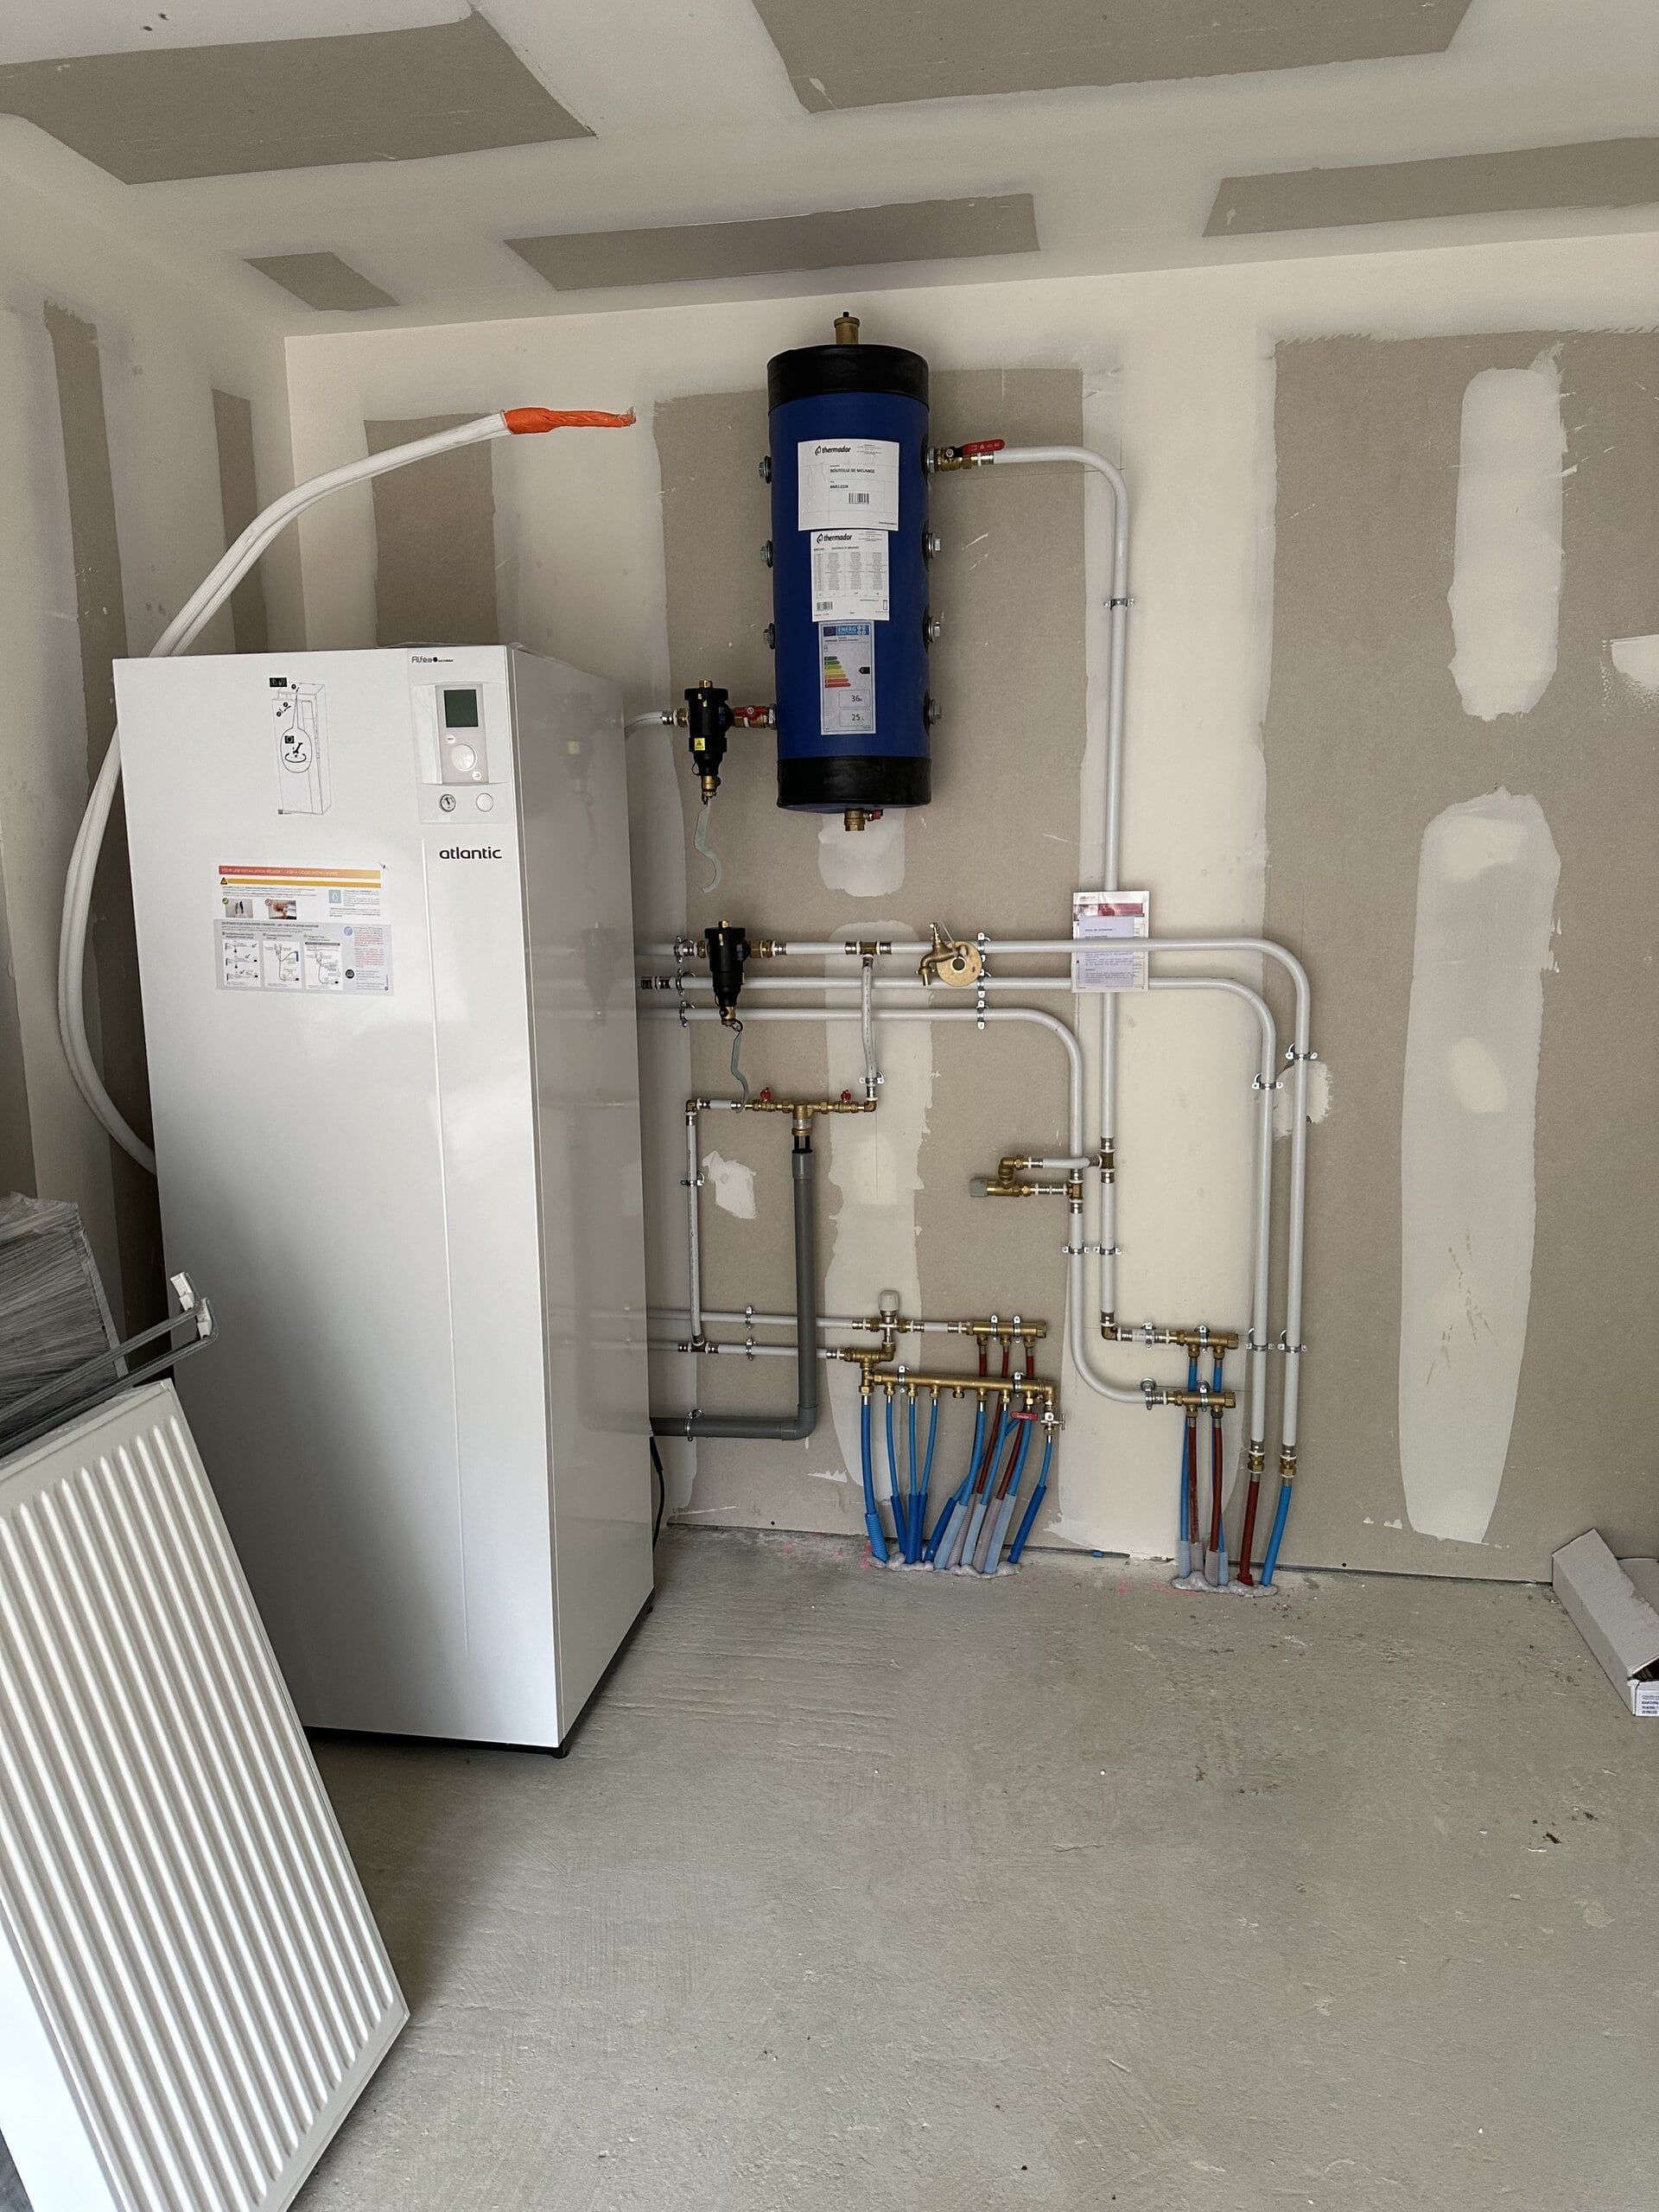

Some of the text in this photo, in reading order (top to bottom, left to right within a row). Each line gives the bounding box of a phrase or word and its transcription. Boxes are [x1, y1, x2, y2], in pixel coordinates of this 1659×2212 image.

[822, 445, 851, 454] thermador
[823, 533, 852, 542] thermador
[439, 846, 502, 859] atlantic
